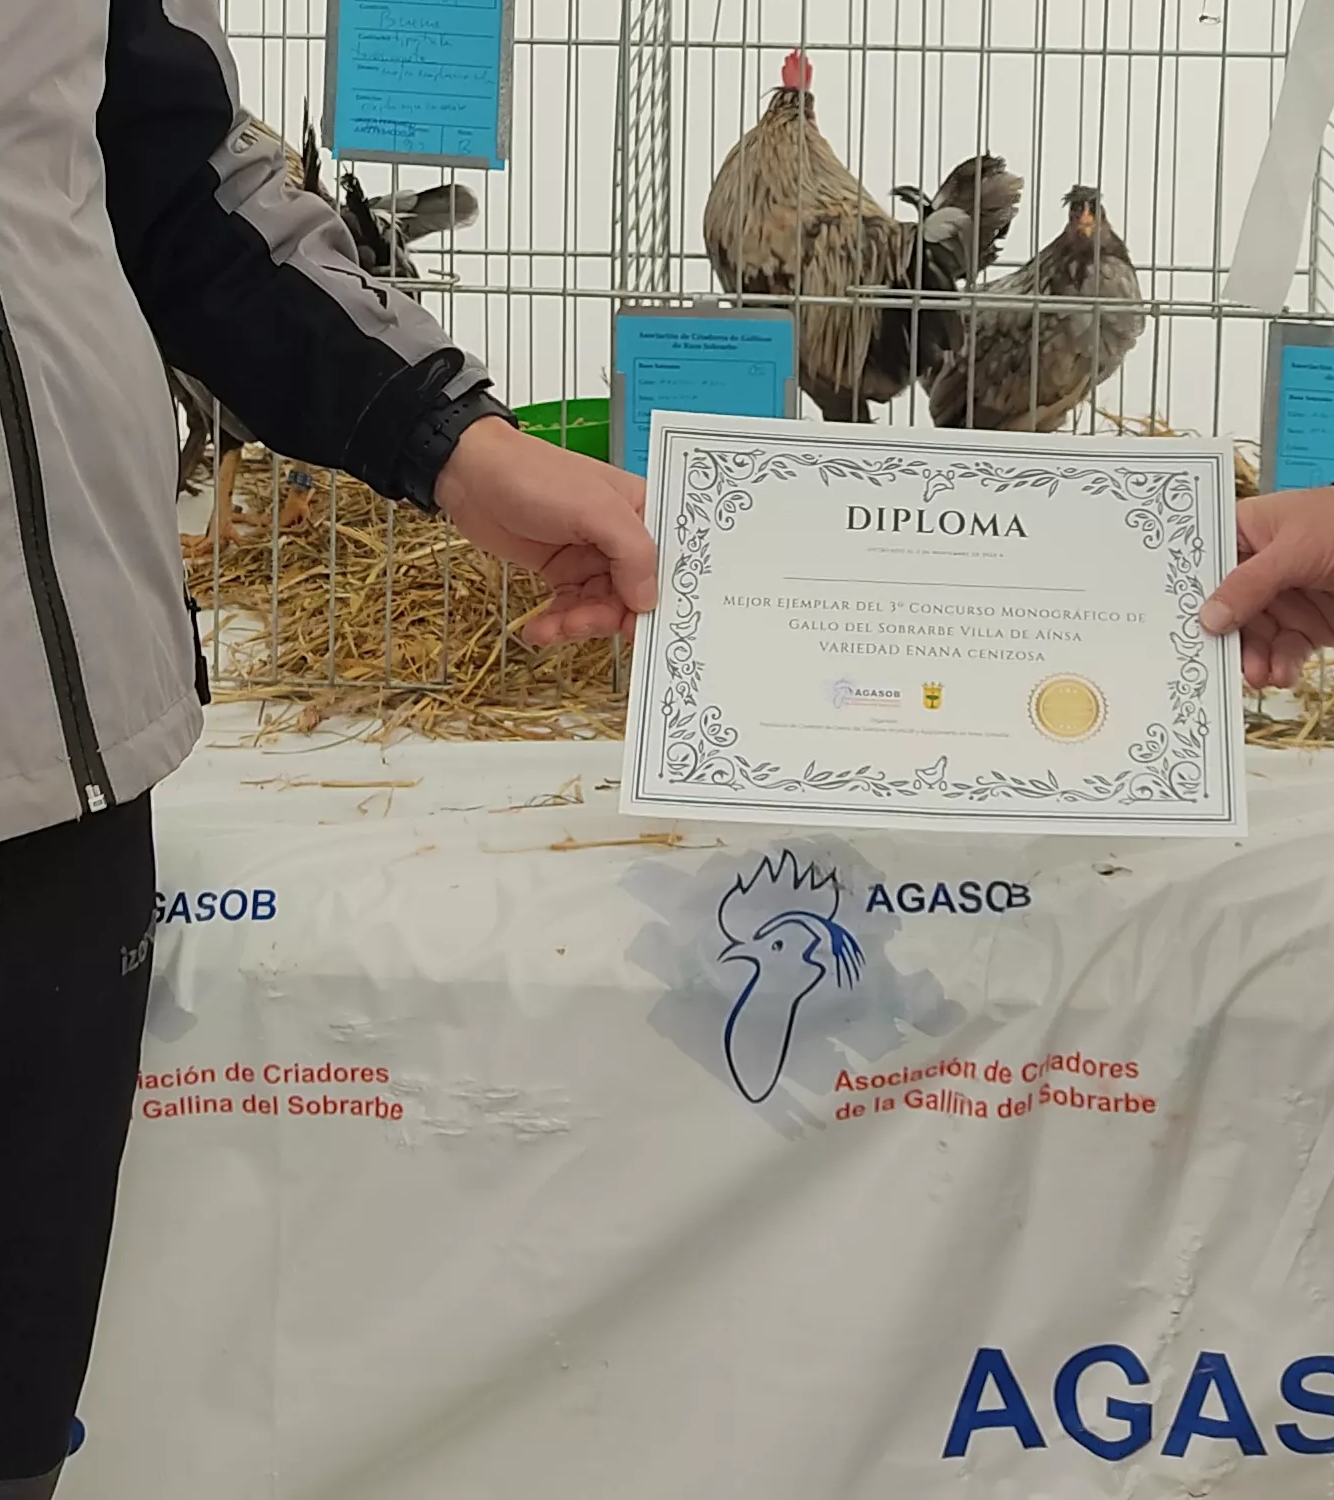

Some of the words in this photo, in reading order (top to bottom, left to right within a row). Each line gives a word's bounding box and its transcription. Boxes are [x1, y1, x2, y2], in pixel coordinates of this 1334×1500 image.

[846, 505, 1029, 538] DIPLOMA
[723, 595, 772, 609] MEJOR
[777, 597, 850, 611] EJEMPLAR
[856, 601, 884, 613] DEL
[909, 602, 996, 617] CONCURSO
[1001, 606, 1121, 622] MONOGRÁFICO
[1126, 612, 1146, 623] DE
[788, 618, 840, 632] GALLO
[845, 621, 873, 633] DEL
[878, 622, 955, 637] SOBRARBE
[960, 625, 1005, 639] VILLA
[1010, 629, 1030, 640] DE
[819, 640, 901, 656] VARIEDAD
[906, 644, 962, 658] ENANA
[967, 648, 1046, 662] CENIZOSA
[854, 688, 901, 698] AGASOB
[865, 880, 1032, 914] AGASOB
[225, 1062, 255, 1083] de
[263, 1062, 390, 1085] Criadores
[834, 1056, 977, 1092] Asociación
[984, 1060, 1013, 1084] de
[1021, 1051, 1140, 1084] Criadores
[142, 1093, 234, 1120] Gallina
[242, 1093, 279, 1116] del
[287, 1093, 405, 1121] Sobrarbe
[835, 1102, 866, 1121] de
[874, 1096, 895, 1113] la
[904, 1088, 989, 1118] Gallina
[997, 1093, 1032, 1119] del
[1038, 1083, 1157, 1115] Sobrarbe
